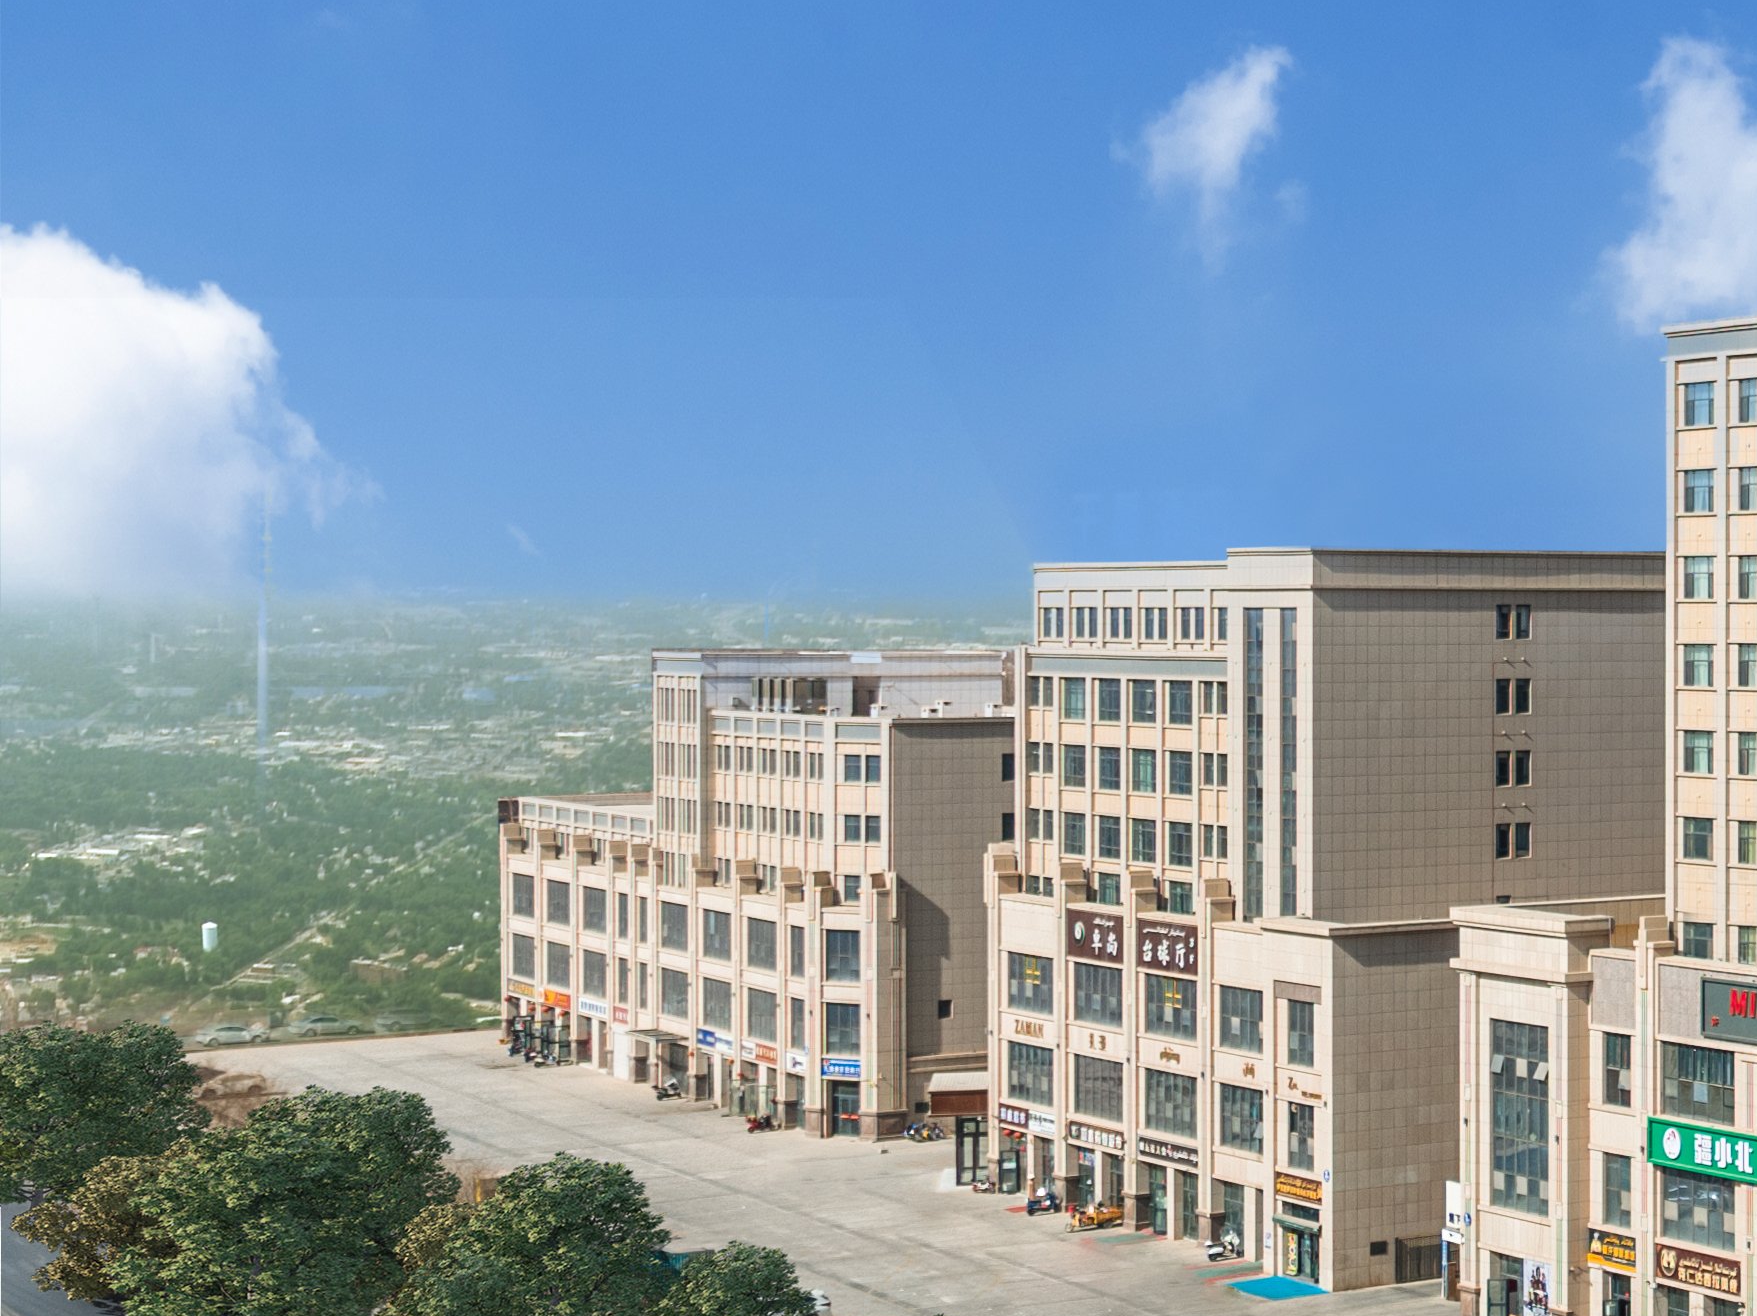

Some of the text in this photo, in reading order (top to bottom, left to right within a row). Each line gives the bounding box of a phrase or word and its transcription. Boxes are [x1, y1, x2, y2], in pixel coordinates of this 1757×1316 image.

[1142, 939, 1186, 968] 台球厅
[1694, 1133, 1753, 1174] 疆小北
